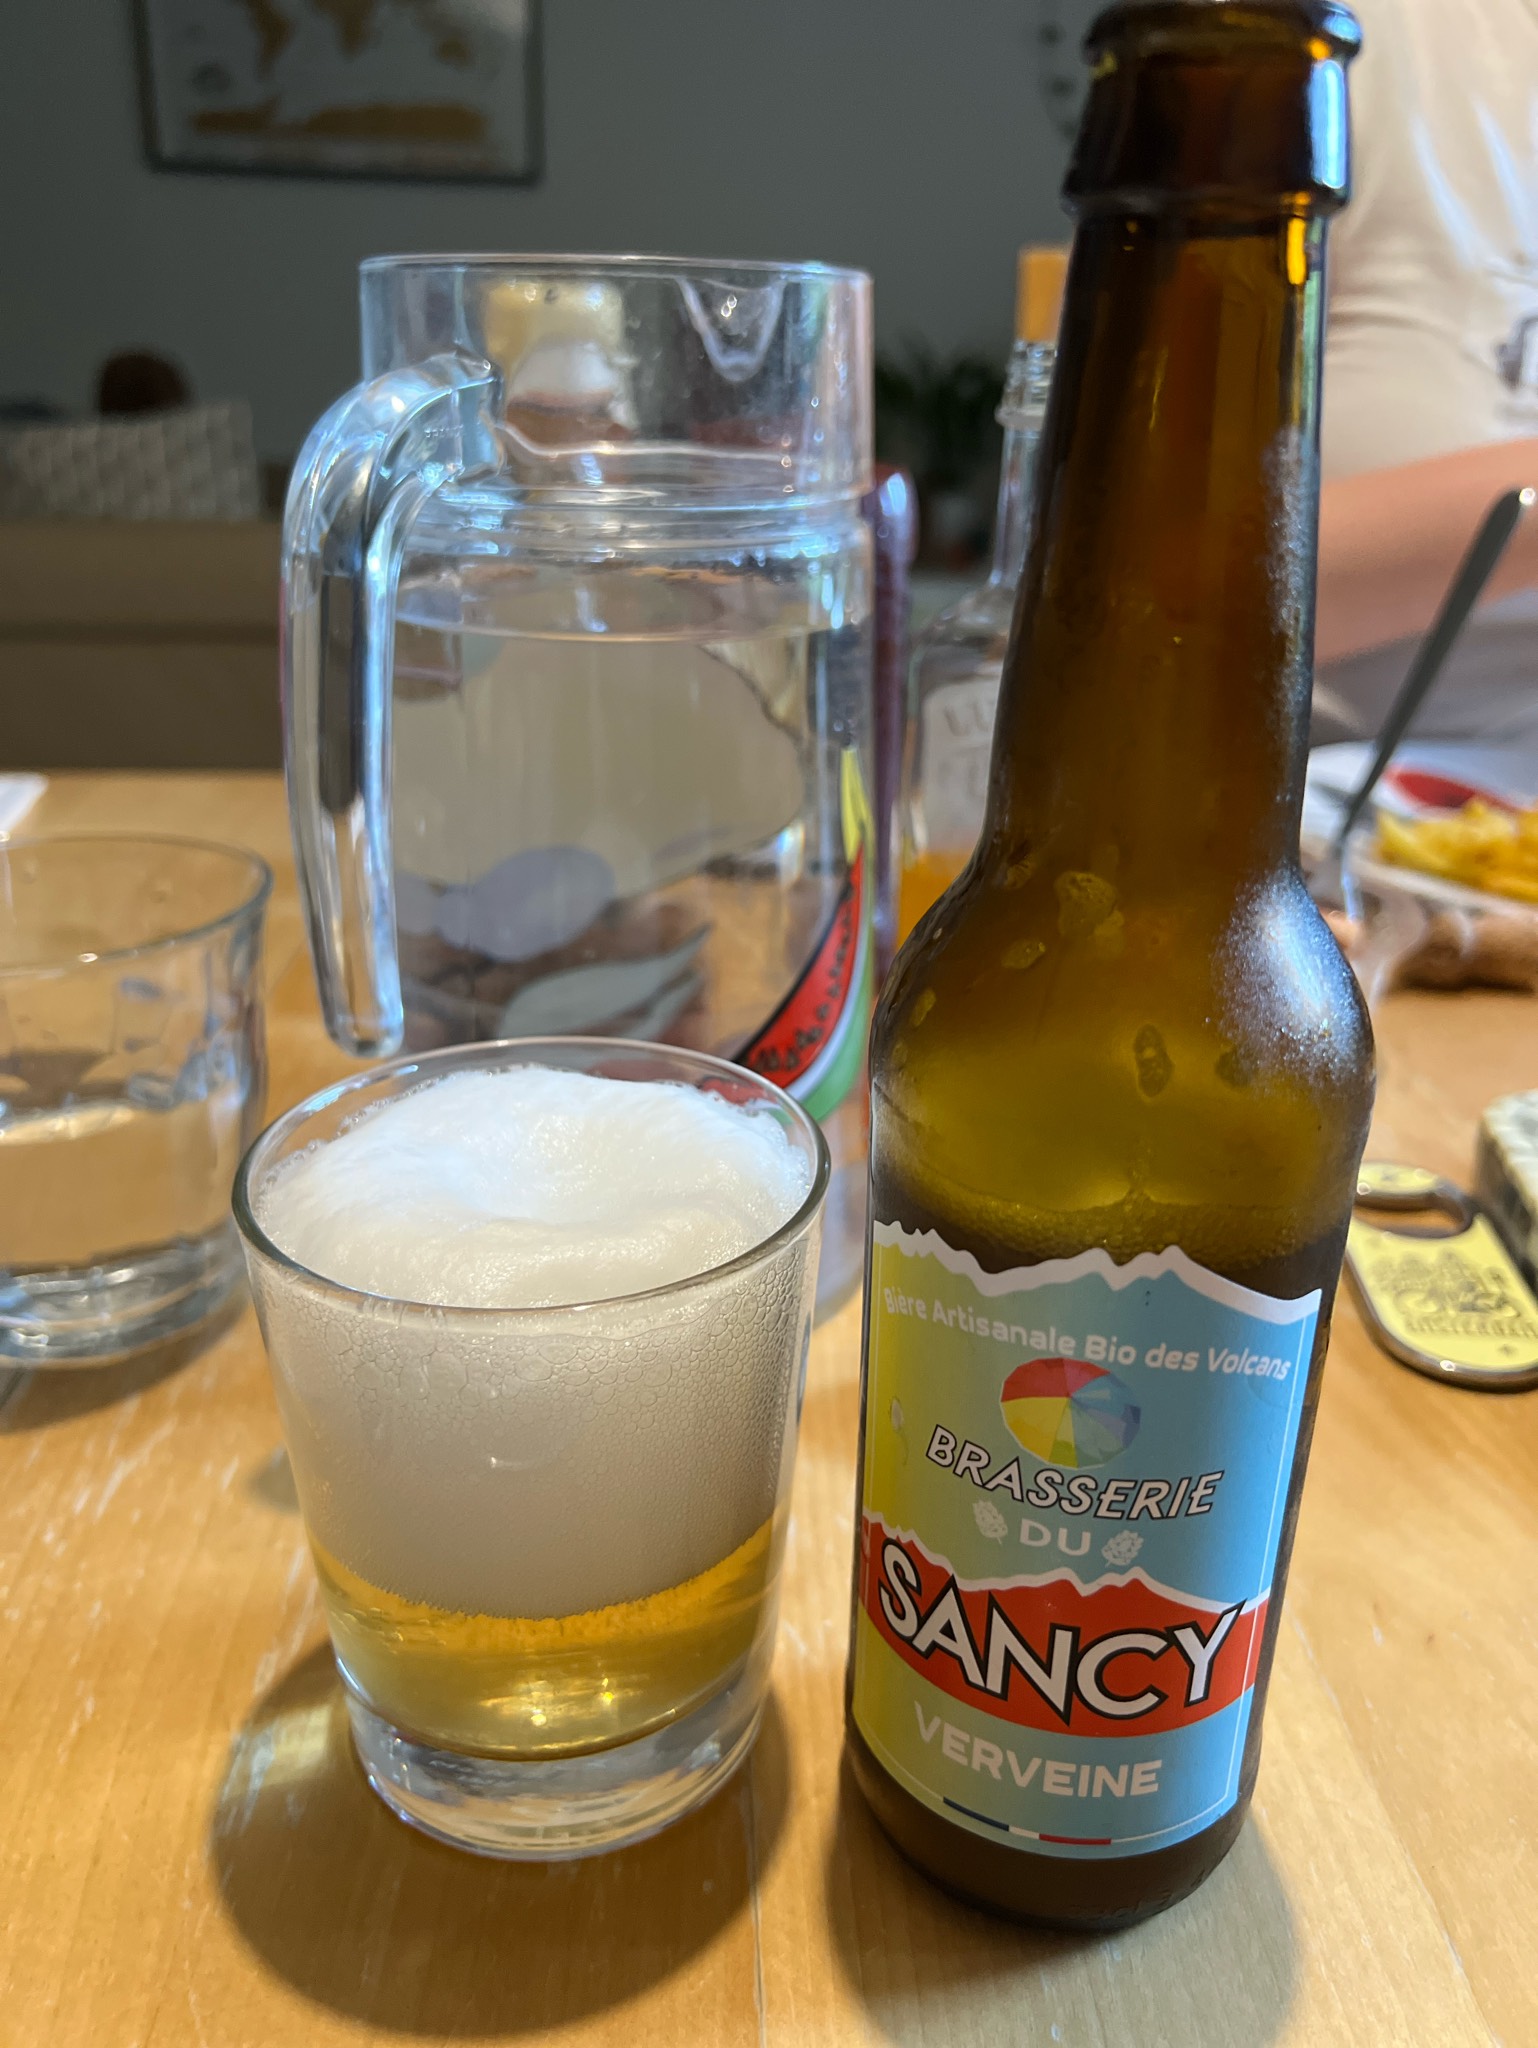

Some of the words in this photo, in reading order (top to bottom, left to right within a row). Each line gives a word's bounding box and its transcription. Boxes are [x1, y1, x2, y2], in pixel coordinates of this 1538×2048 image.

[884, 1287, 926, 1320] Bière
[931, 1299, 1077, 1356] Artisanale
[1084, 1335, 1136, 1365] Bio
[1145, 1342, 1200, 1371] des
[1207, 1346, 1292, 1381] Volcans
[926, 1424, 1225, 1521] BRASSERIE
[1019, 1519, 1091, 1556] DU
[878, 1537, 1248, 1726] SANCY
[914, 1701, 1163, 1798] VERVEINE
